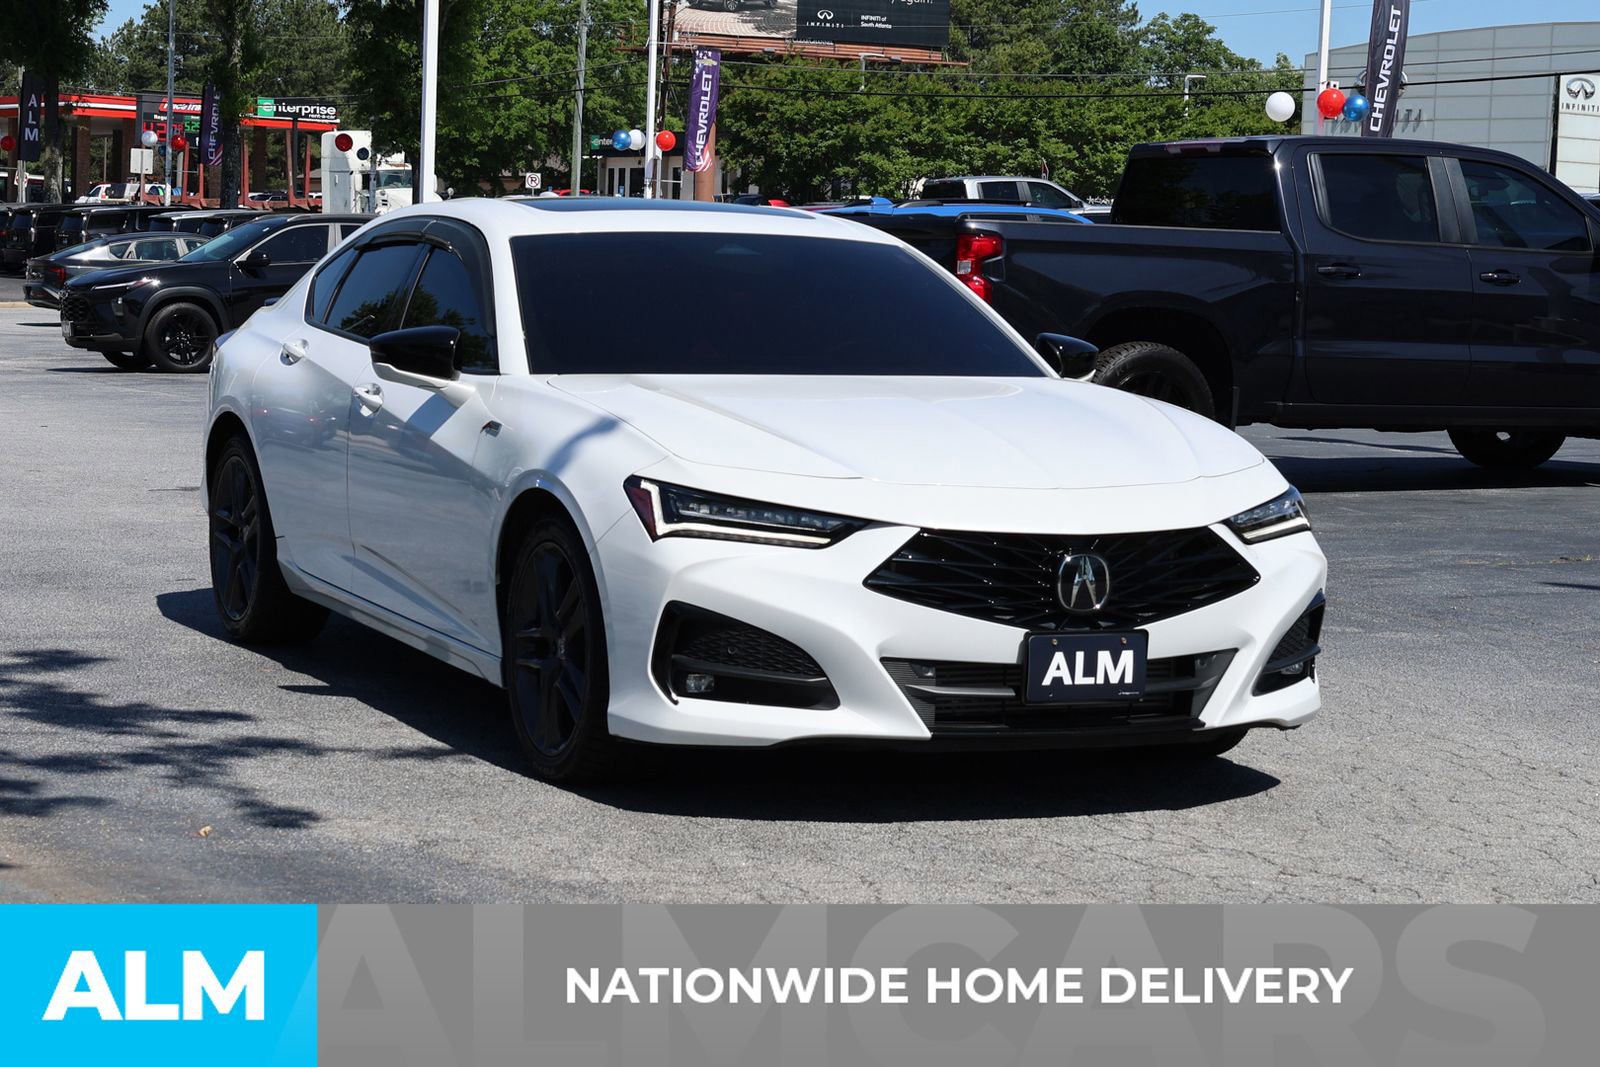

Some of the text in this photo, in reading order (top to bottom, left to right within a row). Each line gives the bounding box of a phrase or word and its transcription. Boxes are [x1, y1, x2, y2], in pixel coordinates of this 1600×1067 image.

[1370, 5, 1401, 131] CHEVROLET
[257, 102, 336, 116] enterprise
[695, 71, 712, 166] CHEVROLET
[1561, 102, 1600, 112] INFINITI
[1042, 650, 1133, 685] ALM
